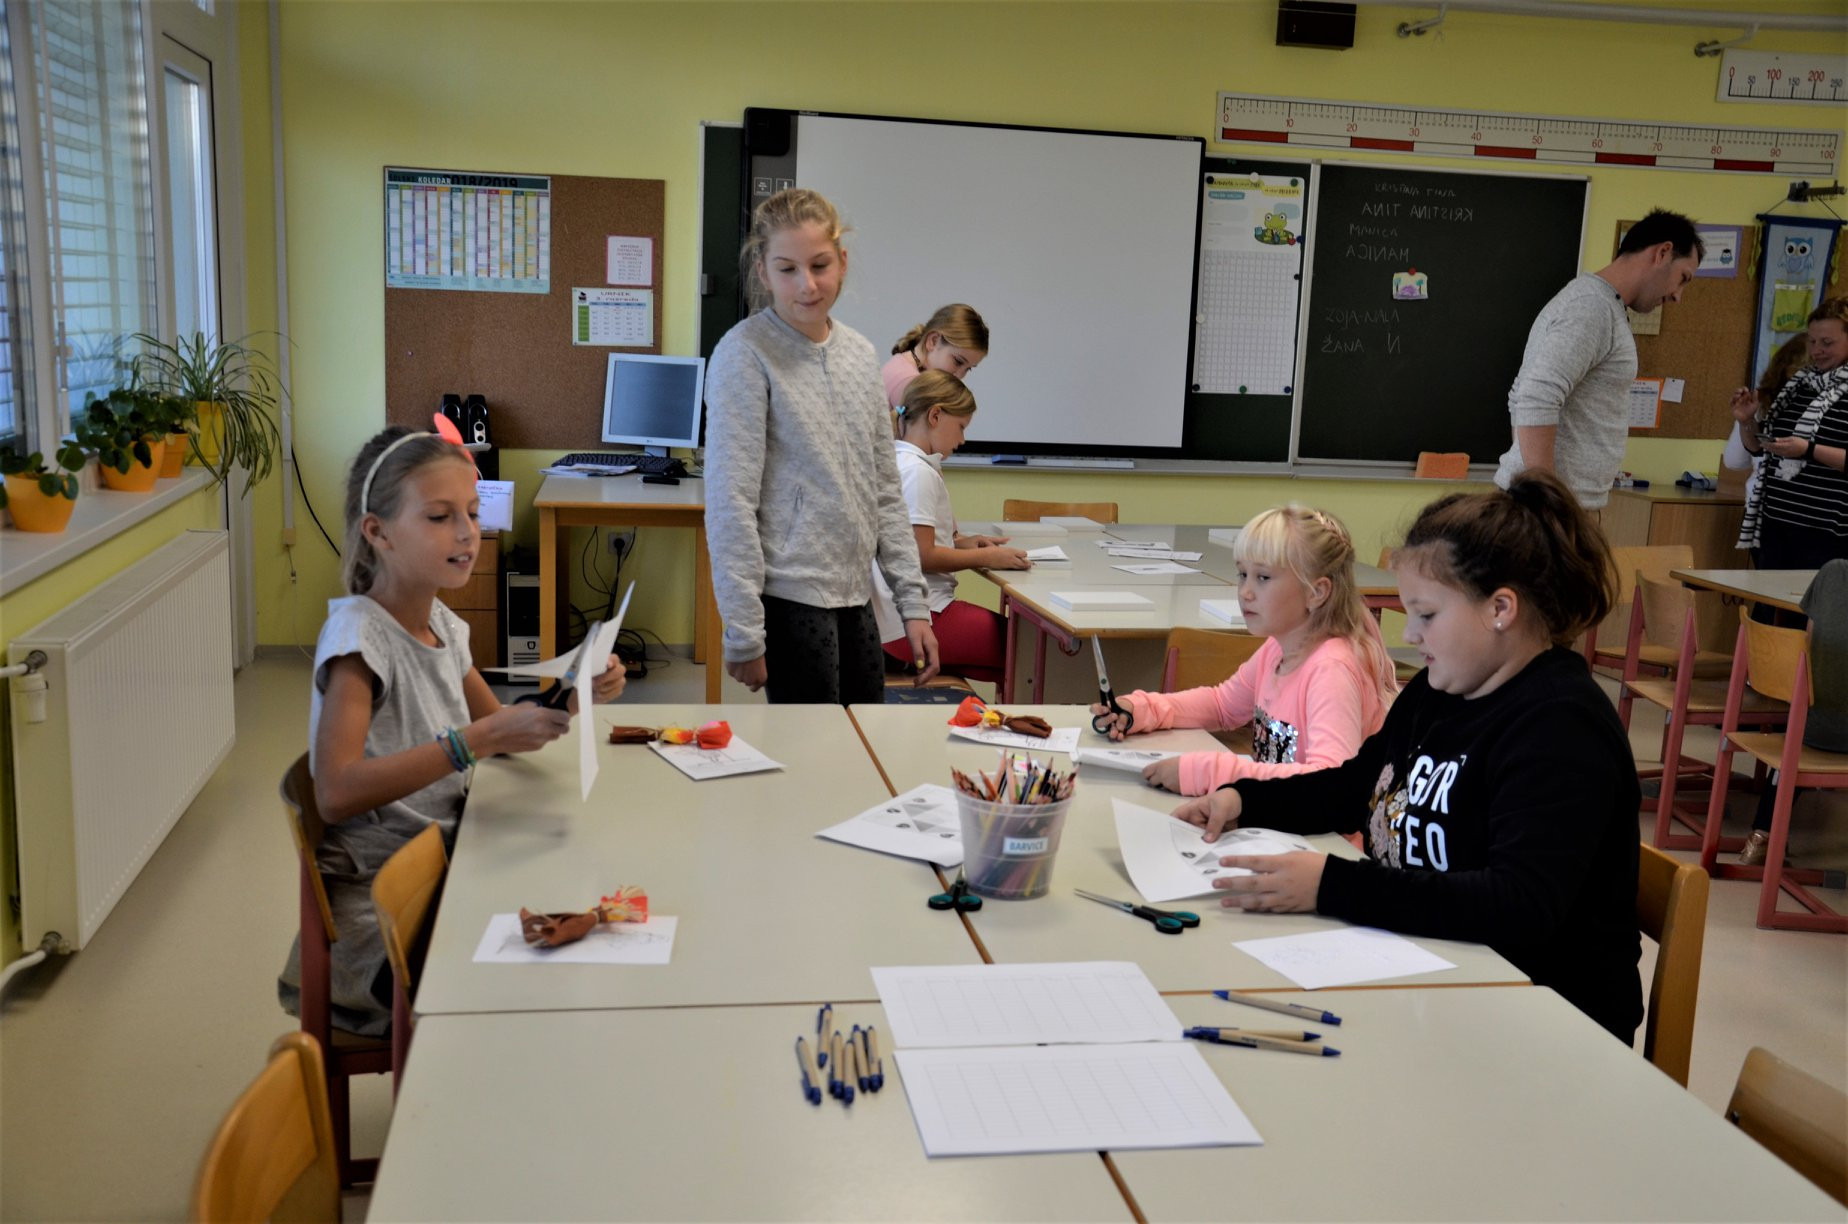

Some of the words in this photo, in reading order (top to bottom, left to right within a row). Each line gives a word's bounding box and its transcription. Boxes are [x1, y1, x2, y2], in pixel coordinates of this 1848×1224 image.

[1729, 66, 1736, 78] 0
[1747, 75, 1756, 85] 50
[1766, 68, 1782, 80] 100
[1788, 77, 1800, 87] 150
[1808, 70, 1825, 82] 200
[1223, 113, 1230, 123] 0
[1286, 117, 1294, 128] 10
[1346, 122, 1358, 133] 20
[1408, 126, 1420, 137] 30
[1471, 131, 1482, 141] 40
[1532, 135, 1543, 145] 50
[1592, 138, 1603, 148] 60
[1652, 142, 1663, 152] 70
[1710, 145, 1722, 155] 80
[1770, 148, 1781, 158] 90
[1820, 149, 1835, 160] 100
[418, 176, 451, 185] KOLEDAR
